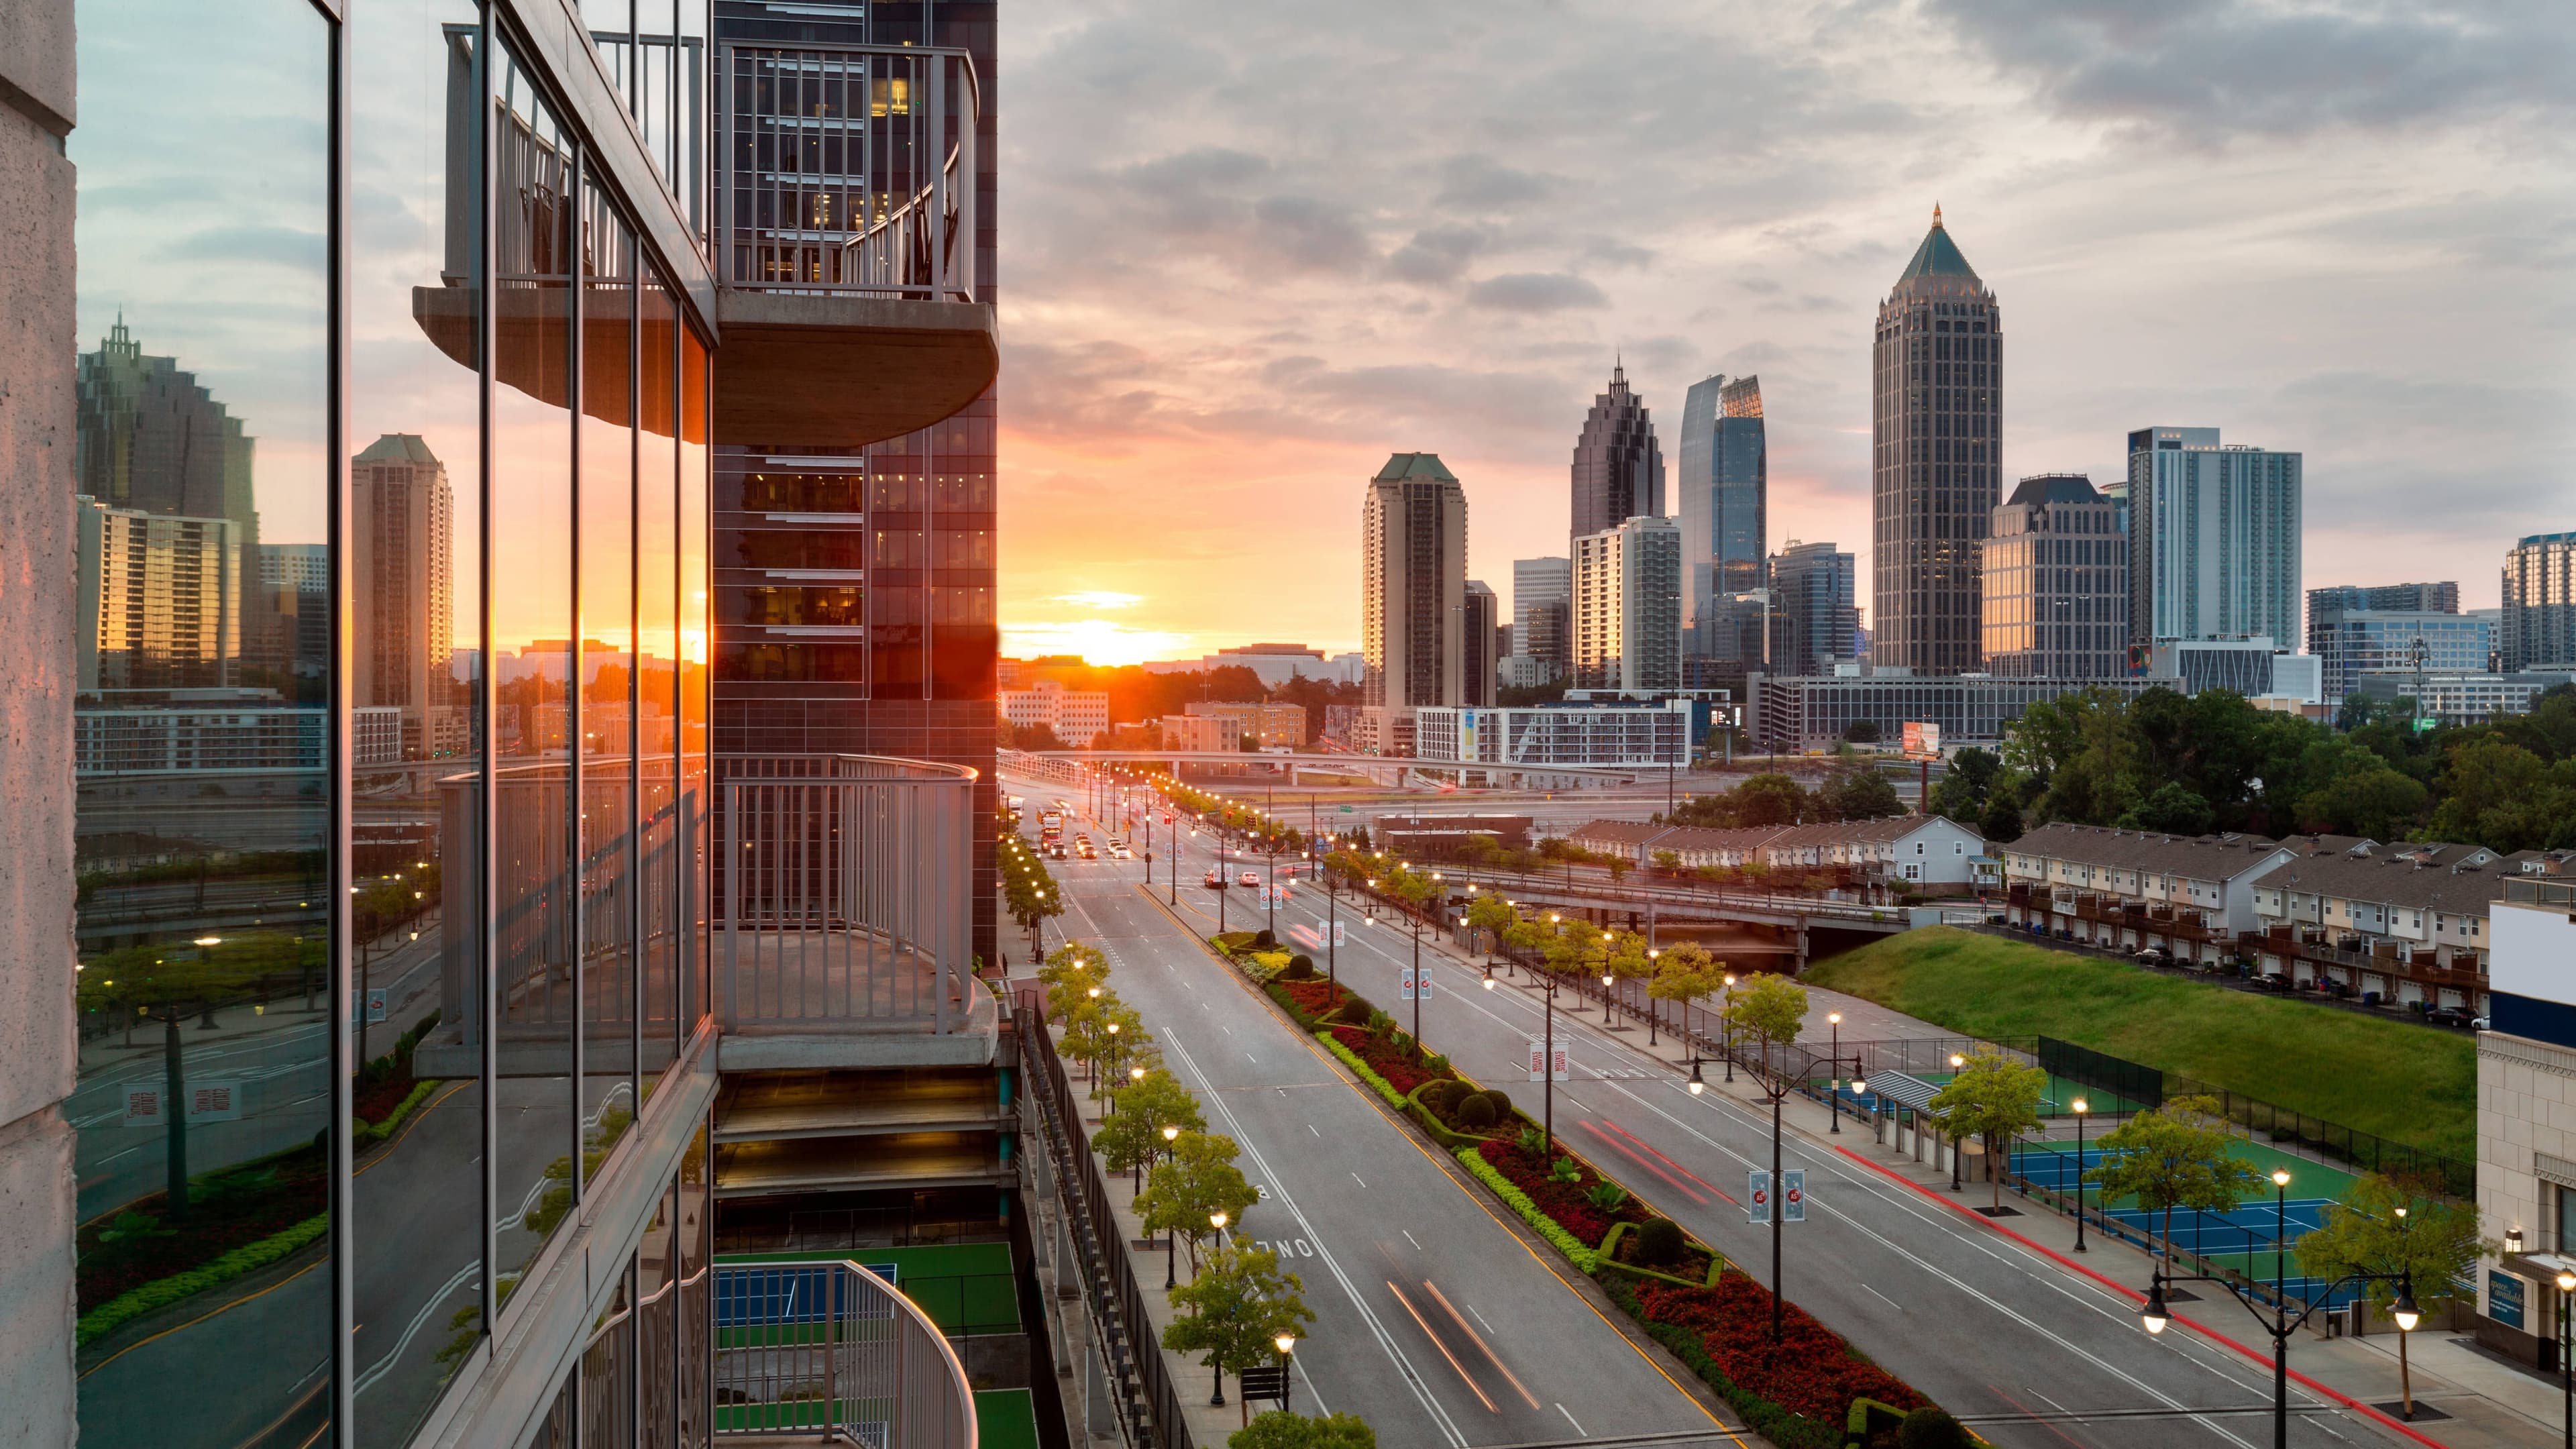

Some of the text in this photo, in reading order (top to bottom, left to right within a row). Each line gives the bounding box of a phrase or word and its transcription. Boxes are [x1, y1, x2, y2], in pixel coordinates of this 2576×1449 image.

[1247, 1239, 1313, 1258] ONL
[2490, 1280, 2508, 1290] space
[2495, 1289, 2523, 1305] available
